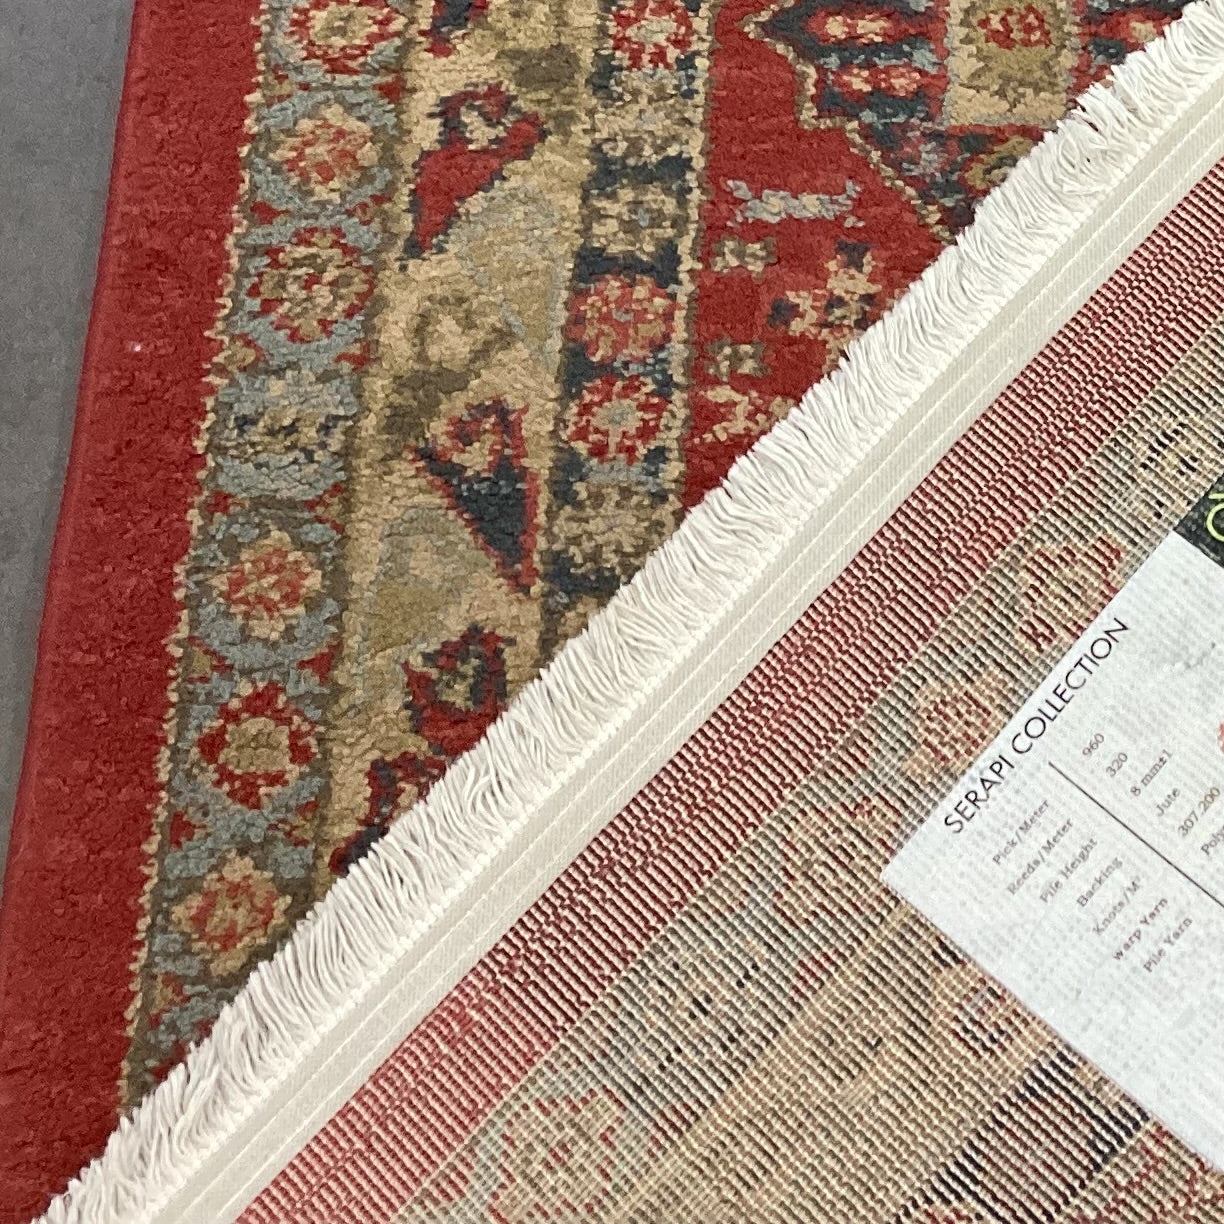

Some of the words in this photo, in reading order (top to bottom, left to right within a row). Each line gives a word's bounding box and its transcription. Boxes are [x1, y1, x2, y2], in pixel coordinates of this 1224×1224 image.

[941, 753, 1015, 836] SERAPI
[1007, 616, 1129, 759] COLLECTION
[1080, 730, 1106, 759] 960
[1104, 749, 1130, 779] 320
[1128, 782, 1142, 798] 8
[1152, 785, 1182, 818] Jute
[1175, 784, 1222, 837] 307.200
[990, 797, 1052, 866] Pick/Meter
[1005, 817, 1075, 896] Reeds/Meter
[1075, 855, 1124, 908] Backing
[1138, 895, 1170, 928] Yarn
[1141, 945, 1167, 973] Pile
[1162, 914, 1194, 949] Yarn
